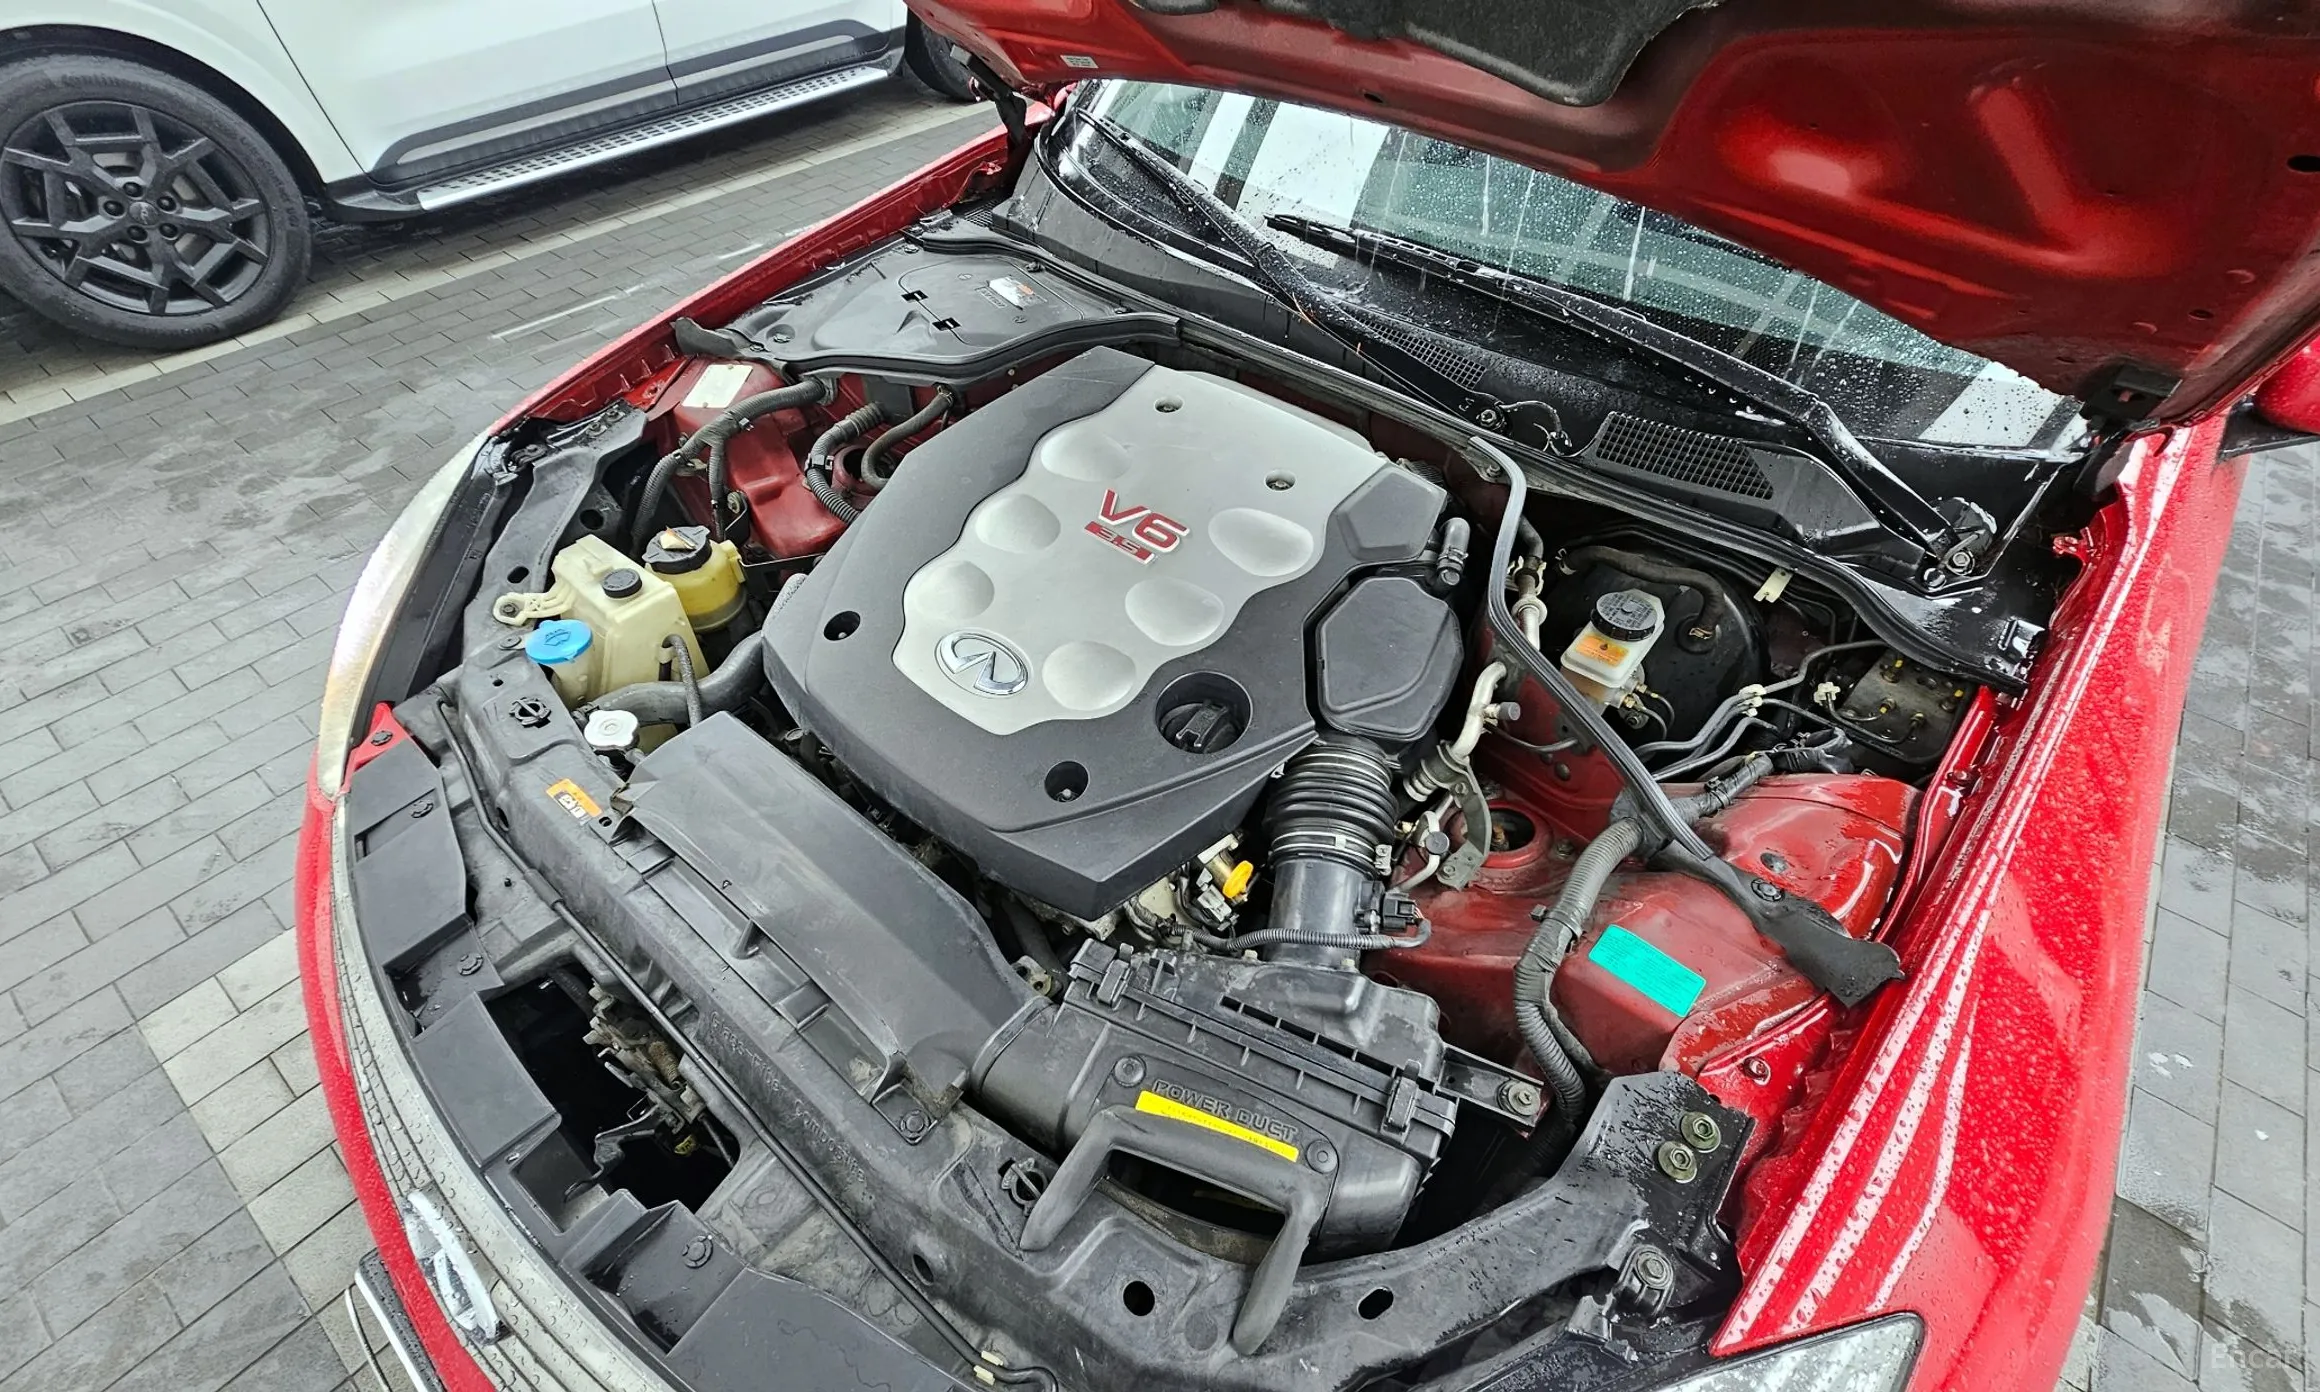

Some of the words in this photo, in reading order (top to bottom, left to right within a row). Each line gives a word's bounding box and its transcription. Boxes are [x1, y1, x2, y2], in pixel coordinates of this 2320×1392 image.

[1099, 488, 1190, 553] V6
[1152, 1078, 1232, 1120] POWER
[1235, 1107, 1299, 1144] DUCT
